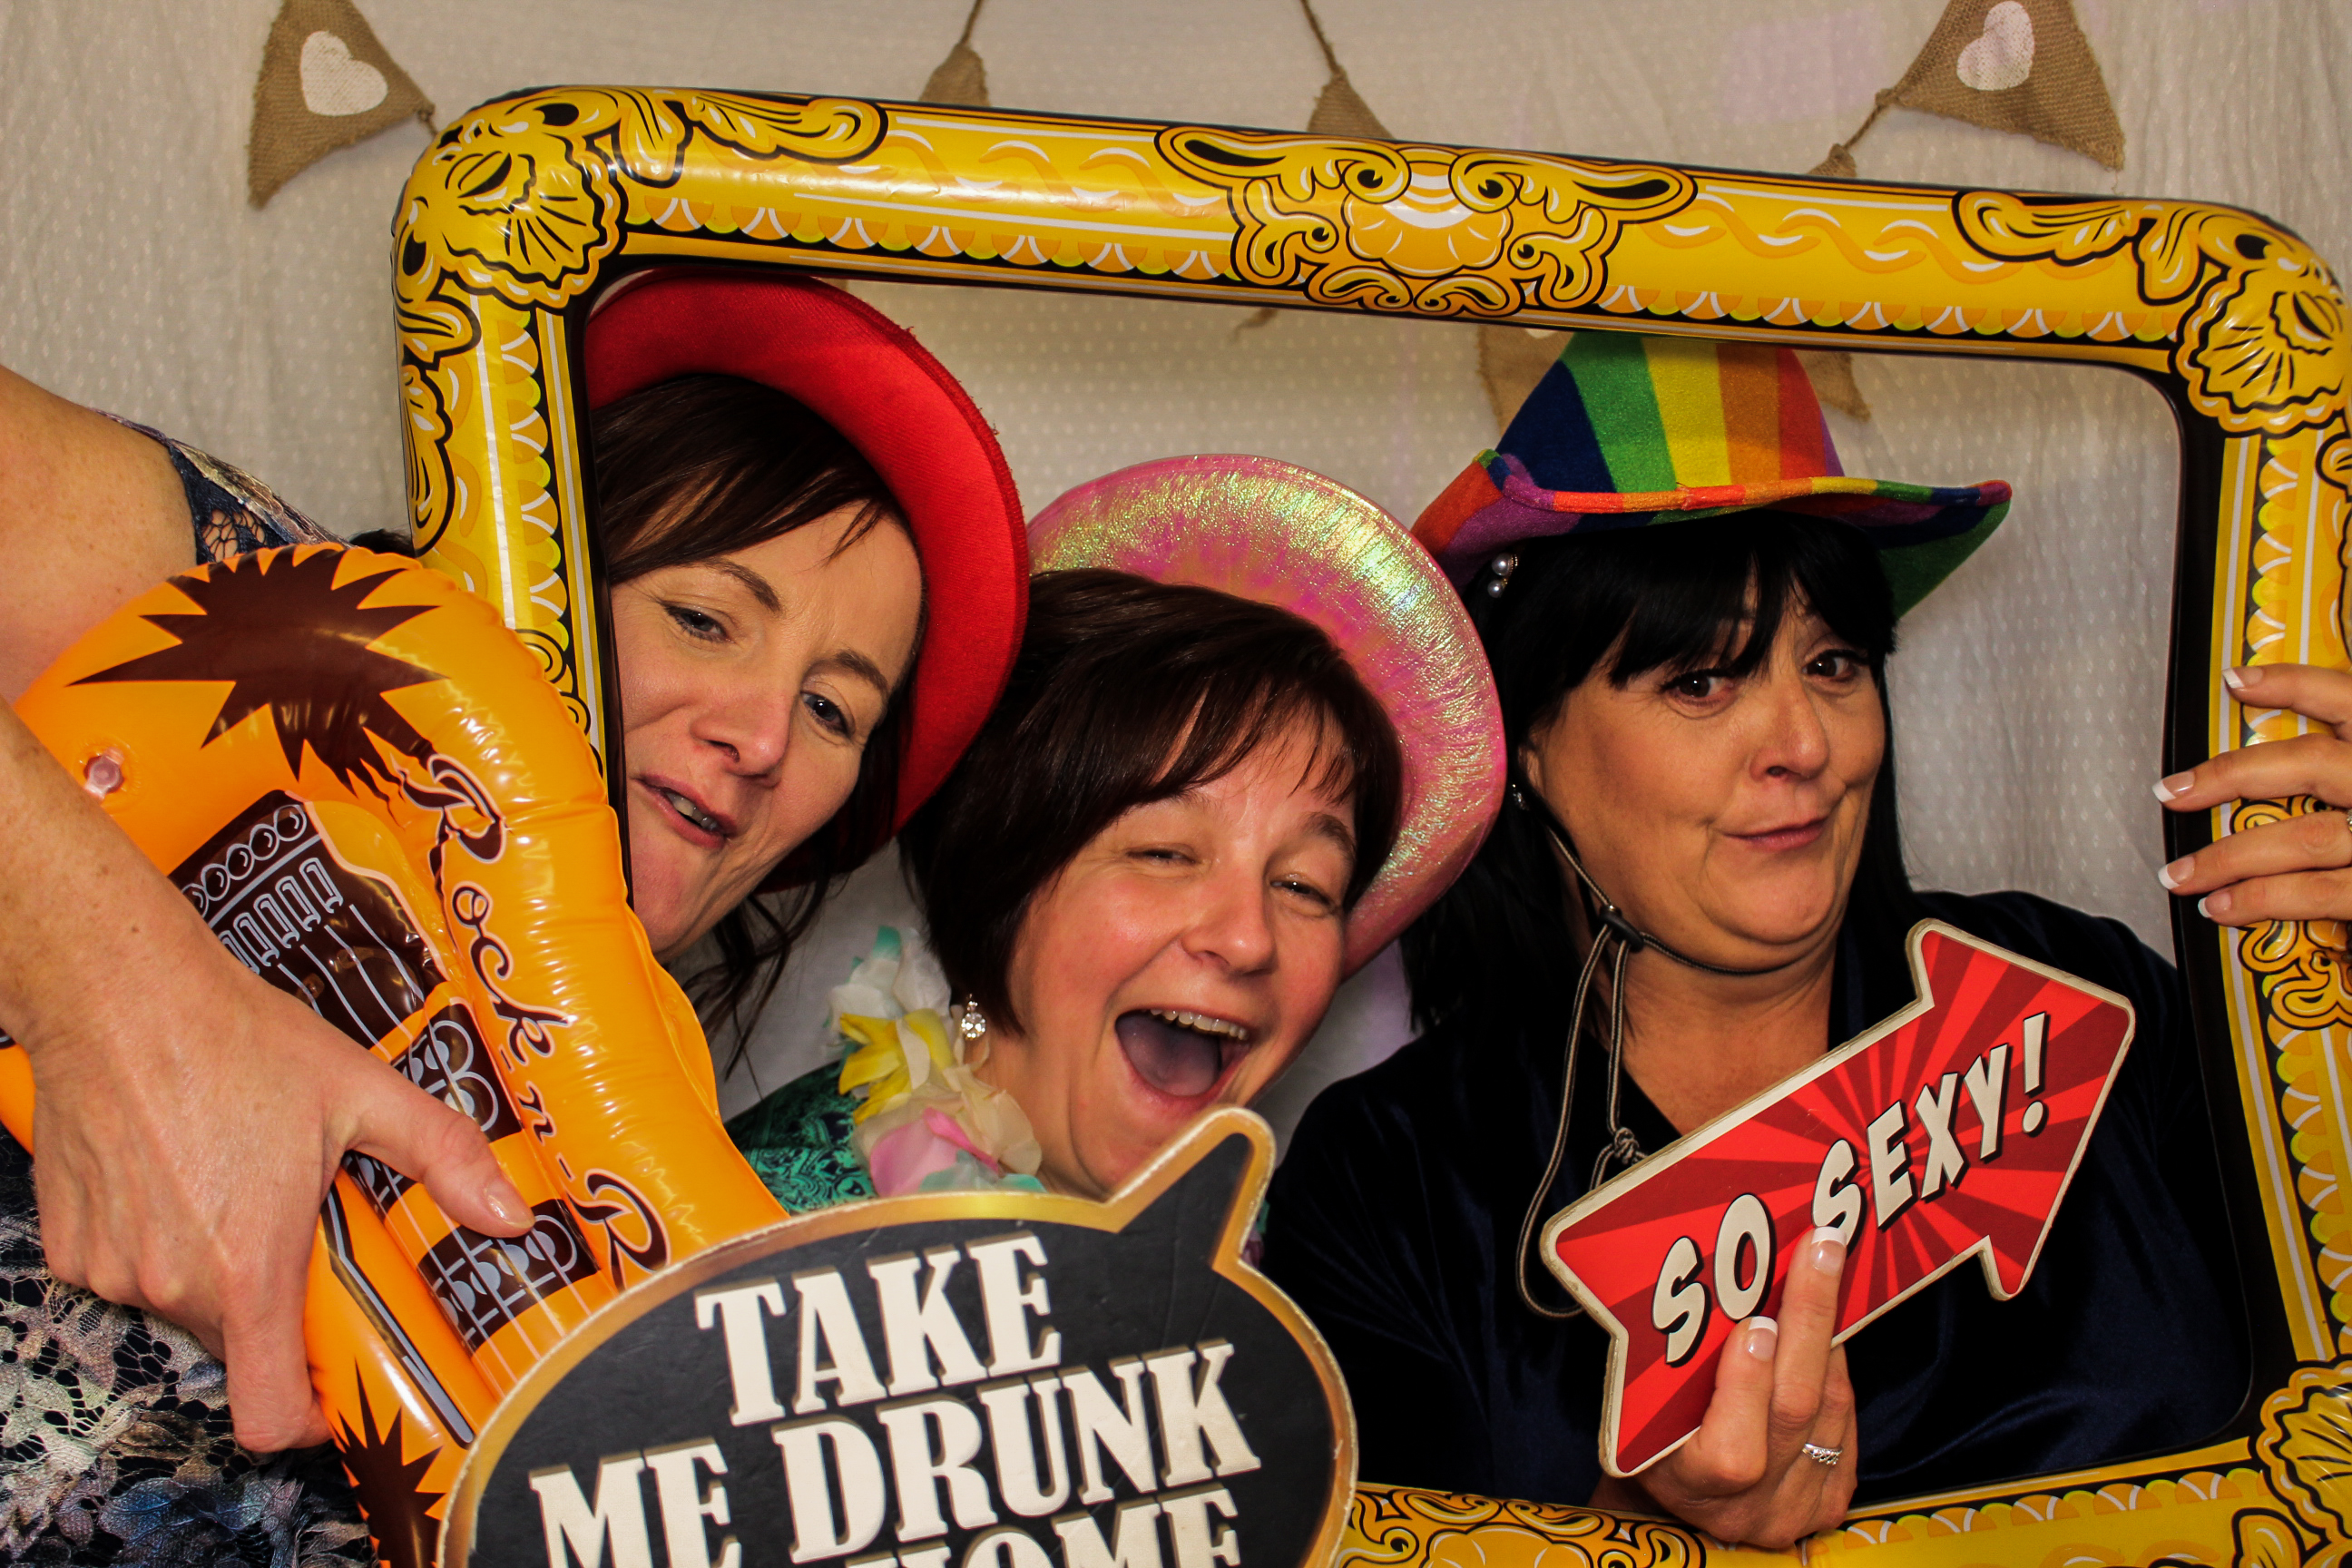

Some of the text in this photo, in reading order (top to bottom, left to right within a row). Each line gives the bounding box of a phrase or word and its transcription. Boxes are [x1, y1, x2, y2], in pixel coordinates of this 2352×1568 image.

[1651, 1011, 2049, 1367] SO SEXY!
[694, 1231, 1062, 1427] TAKE
[528, 1436, 742, 1568] ME
[771, 1340, 1261, 1564] DRUNK
